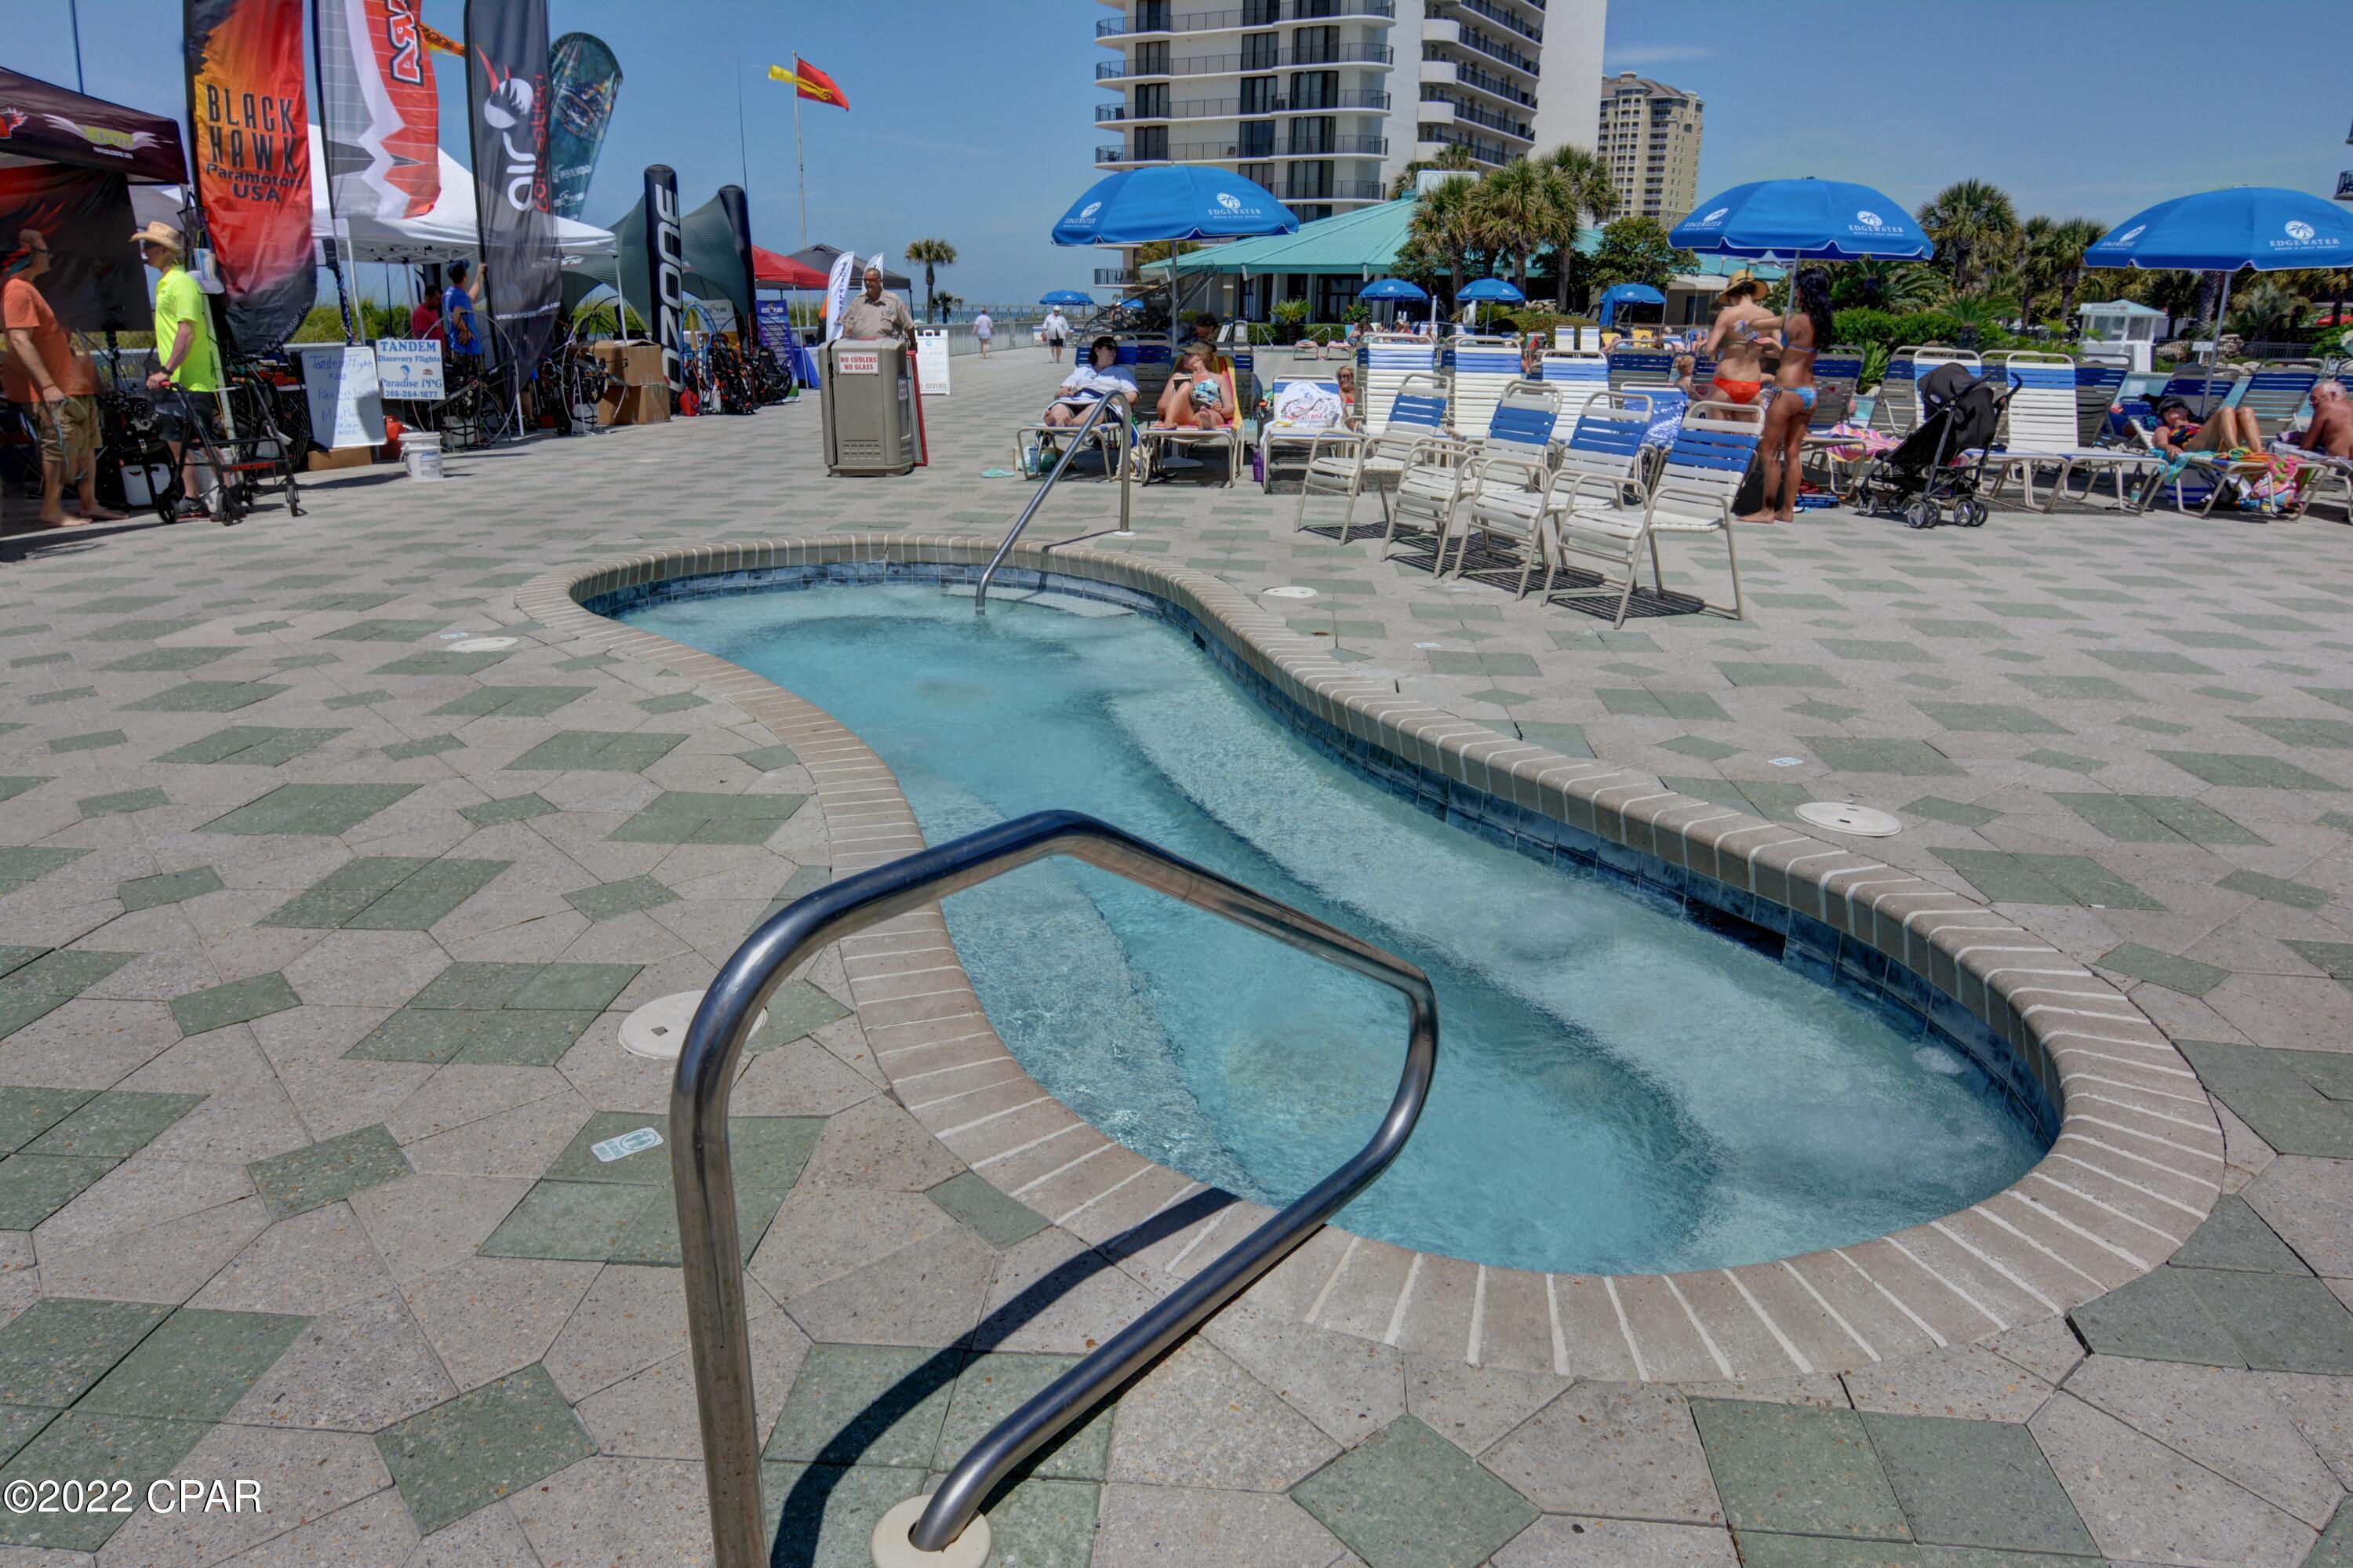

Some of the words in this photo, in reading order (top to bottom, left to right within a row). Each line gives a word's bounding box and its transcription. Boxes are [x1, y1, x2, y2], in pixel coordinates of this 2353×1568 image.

[206, 83, 297, 135] BLACK
[209, 126, 298, 175] HAWK
[205, 162, 304, 189] Paramotors
[233, 184, 281, 202] USA
[1848, 224, 1904, 233] EDGEWATER
[380, 341, 436, 352] TANDEM
[309, 355, 345, 370] Tandem
[377, 355, 413, 363] Discovery
[380, 377, 418, 388] Paradise
[422, 379, 442, 388] PPG
